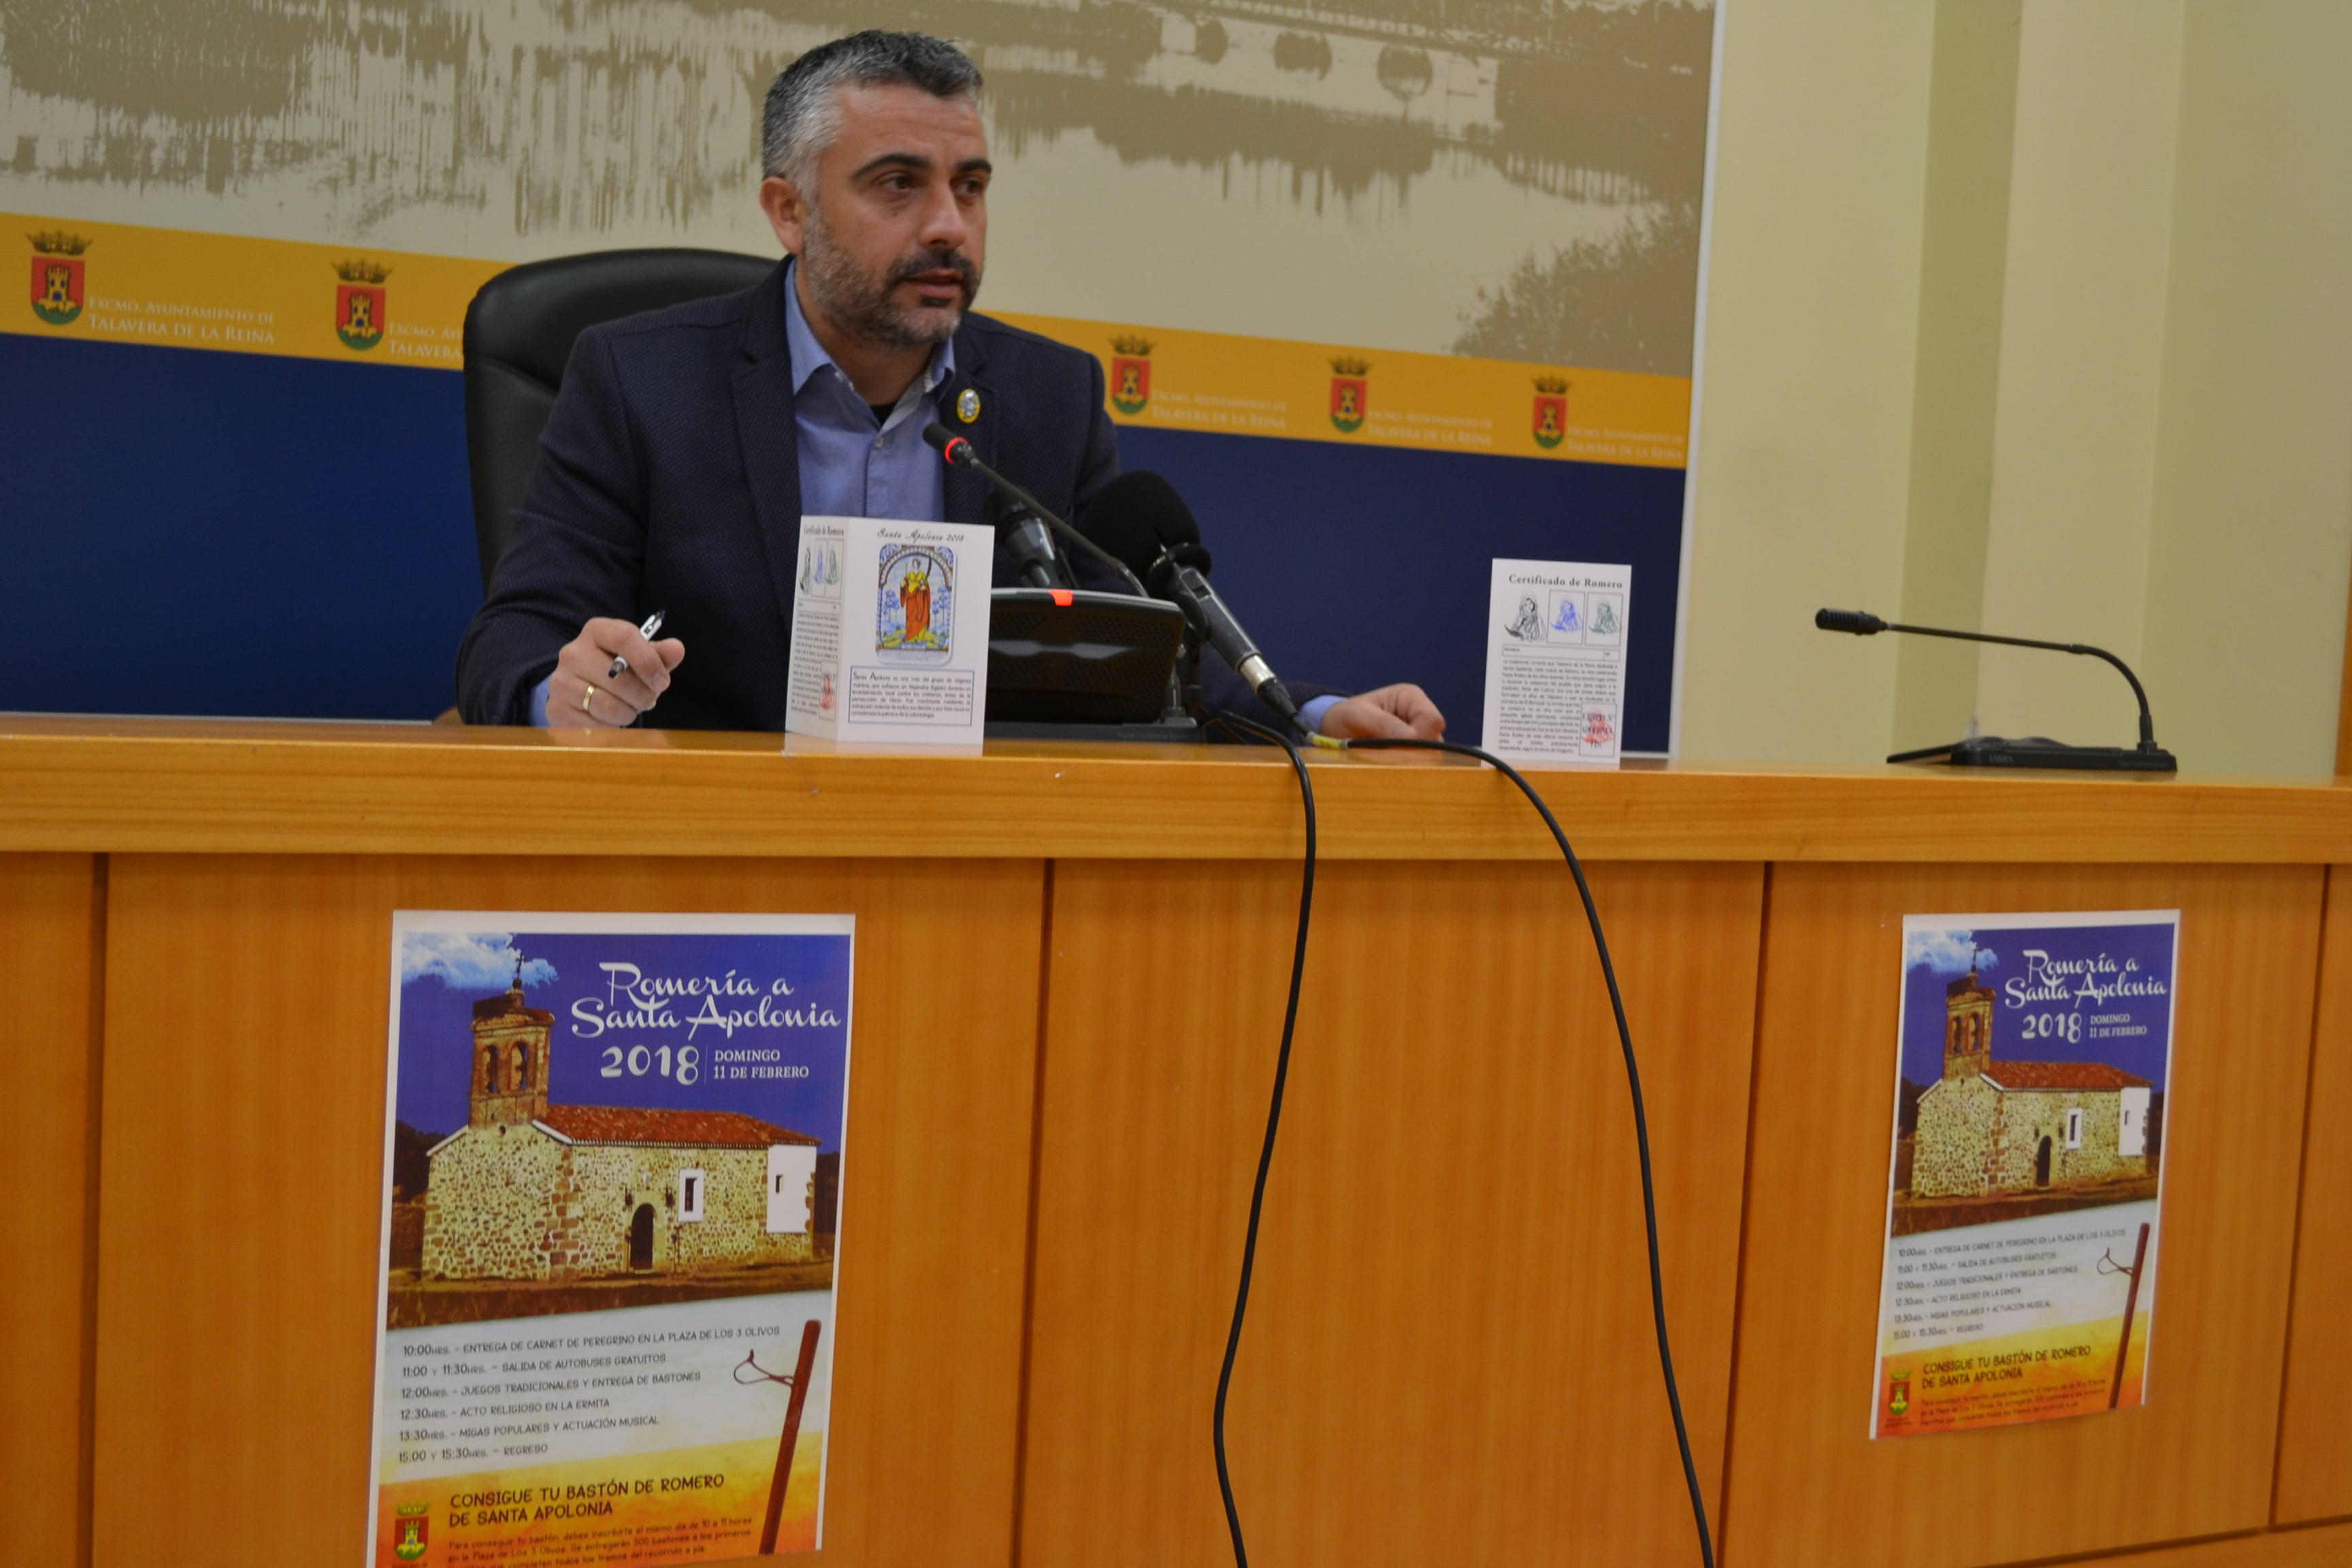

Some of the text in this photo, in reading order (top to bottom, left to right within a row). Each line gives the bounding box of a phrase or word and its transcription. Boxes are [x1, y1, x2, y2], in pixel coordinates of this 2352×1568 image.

[90, 314, 274, 344] TALAVERA DE LA REINA
[1509, 574, 1622, 589] Certificado de Romero
[2023, 949, 2139, 986] Romería a
[599, 962, 794, 1010] Romería a
[2005, 972, 2167, 1009] Santa Apolonia
[572, 995, 841, 1041] Santa Apolonia
[2021, 1013, 2082, 1043] 2018
[2090, 1013, 2130, 1024] DOMINGO
[2089, 1026, 2147, 1039] 11 DE FEBRERO
[600, 1045, 700, 1085] 2018
[715, 1049, 781, 1062] DOMINGO
[713, 1065, 809, 1079] 11 DE FEBRERO
[463, 1342, 507, 1354] ENTREGA
[511, 1341, 523, 1351] DE
[527, 1339, 564, 1350] CARNET
[567, 1339, 578, 1348] DE
[583, 1335, 634, 1346] PEREGRINO
[638, 1335, 650, 1343] EN
[653, 1333, 665, 1343] LA
[668, 1331, 696, 1341] PLAZA
[700, 1330, 711, 1340] DE
[715, 1328, 733, 1339] LOS
[736, 1328, 742, 1338] 3
[745, 1326, 780, 1337] OLIVOS
[403, 1365, 427, 1377] 11:00
[502, 1362, 536, 1373] SALIDA
[539, 1361, 551, 1371] DE
[555, 1357, 611, 1369] AUTOBUSES
[615, 1354, 666, 1365] GRATUITOS
[1923, 1345, 2091, 1375] CONSIGUE TU BASTÓN DE ROMERO
[461, 1384, 501, 1395] JUEGOS
[505, 1379, 578, 1393] TRADICIONALES
[583, 1379, 589, 1388] Y
[592, 1376, 634, 1388] ENTREGA
[637, 1375, 650, 1386] DE
[653, 1372, 700, 1384] BASTONES
[1922, 1367, 2023, 1389] DE SANTA APOLONIA
[460, 1406, 487, 1418] ACTO
[490, 1403, 542, 1416] RELIGIOSO
[545, 1401, 557, 1411] EN
[560, 1400, 572, 1410] LA
[576, 1399, 610, 1409] ERMITA
[459, 1428, 490, 1438] MIGAS
[494, 1422, 550, 1436] POPULARES
[553, 1422, 559, 1431] Y
[563, 1417, 616, 1430] ACTUACIÓN
[619, 1416, 659, 1426] MUSICAL
[399, 1450, 426, 1463] 15:00
[504, 1444, 548, 1456] REGRESO
[451, 1474, 724, 1509] CONSIGUE TU BASTÓN DE ROMERO
[449, 1501, 612, 1528] DE SANTA APOLONIA
